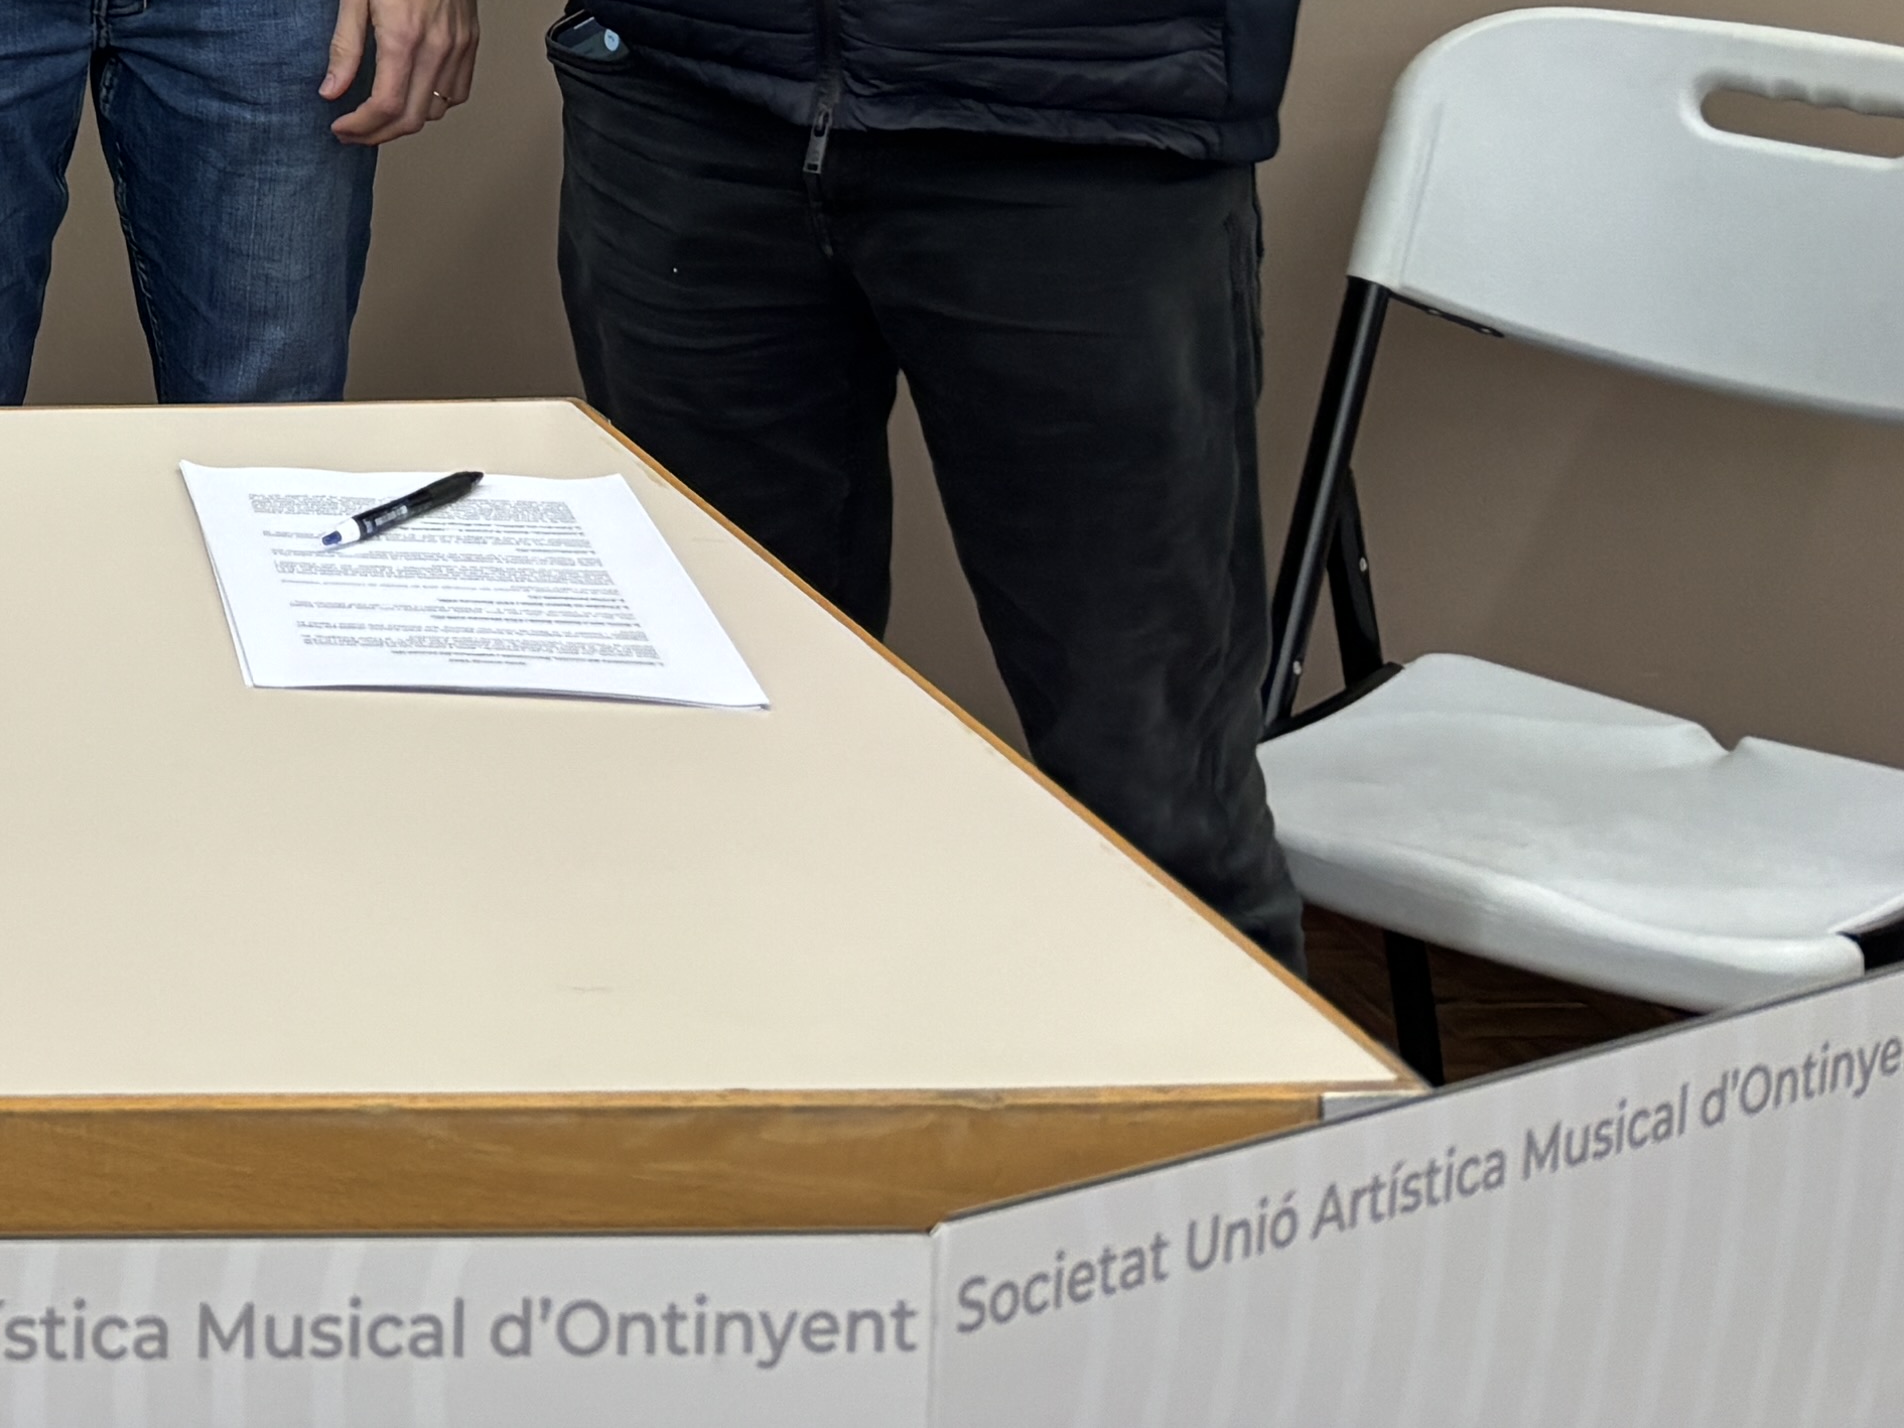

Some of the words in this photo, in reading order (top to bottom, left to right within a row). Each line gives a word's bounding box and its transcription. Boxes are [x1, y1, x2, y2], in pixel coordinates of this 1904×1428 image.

[955, 1231, 1171, 1334] Societat
[1186, 1189, 1299, 1274] Unió
[1309, 1144, 1507, 1240] Artística
[1521, 1081, 1689, 1182] Musical
[1700, 1034, 1904, 1128] d'Ontinye
[197, 1296, 465, 1360] Musical
